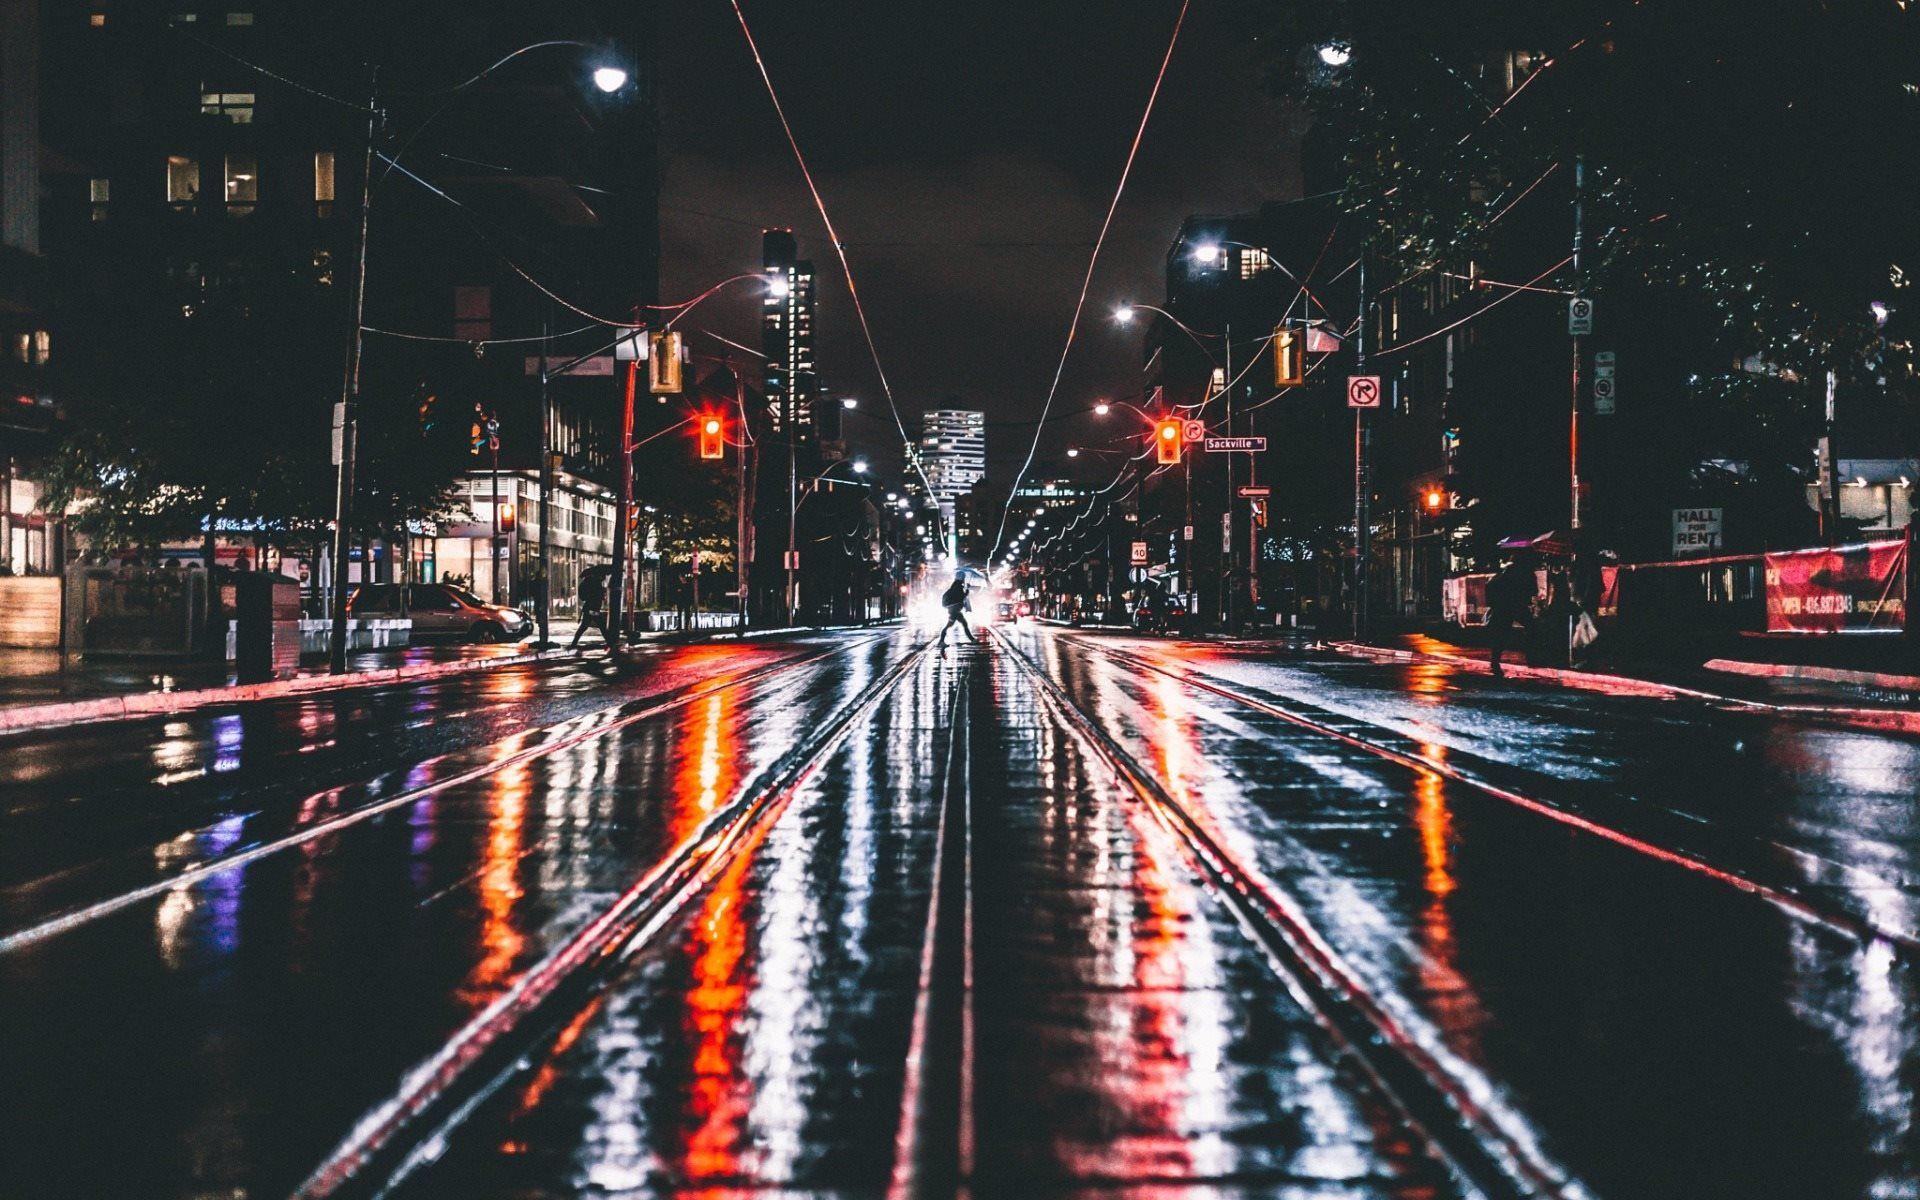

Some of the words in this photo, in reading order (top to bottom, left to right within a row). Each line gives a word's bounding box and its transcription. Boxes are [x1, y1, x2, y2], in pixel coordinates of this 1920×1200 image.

[1208, 439, 1252, 449] Sackville
[1677, 510, 1717, 522] HALL
[1677, 532, 1719, 545] RENT
[1134, 549, 1145, 557] 40
